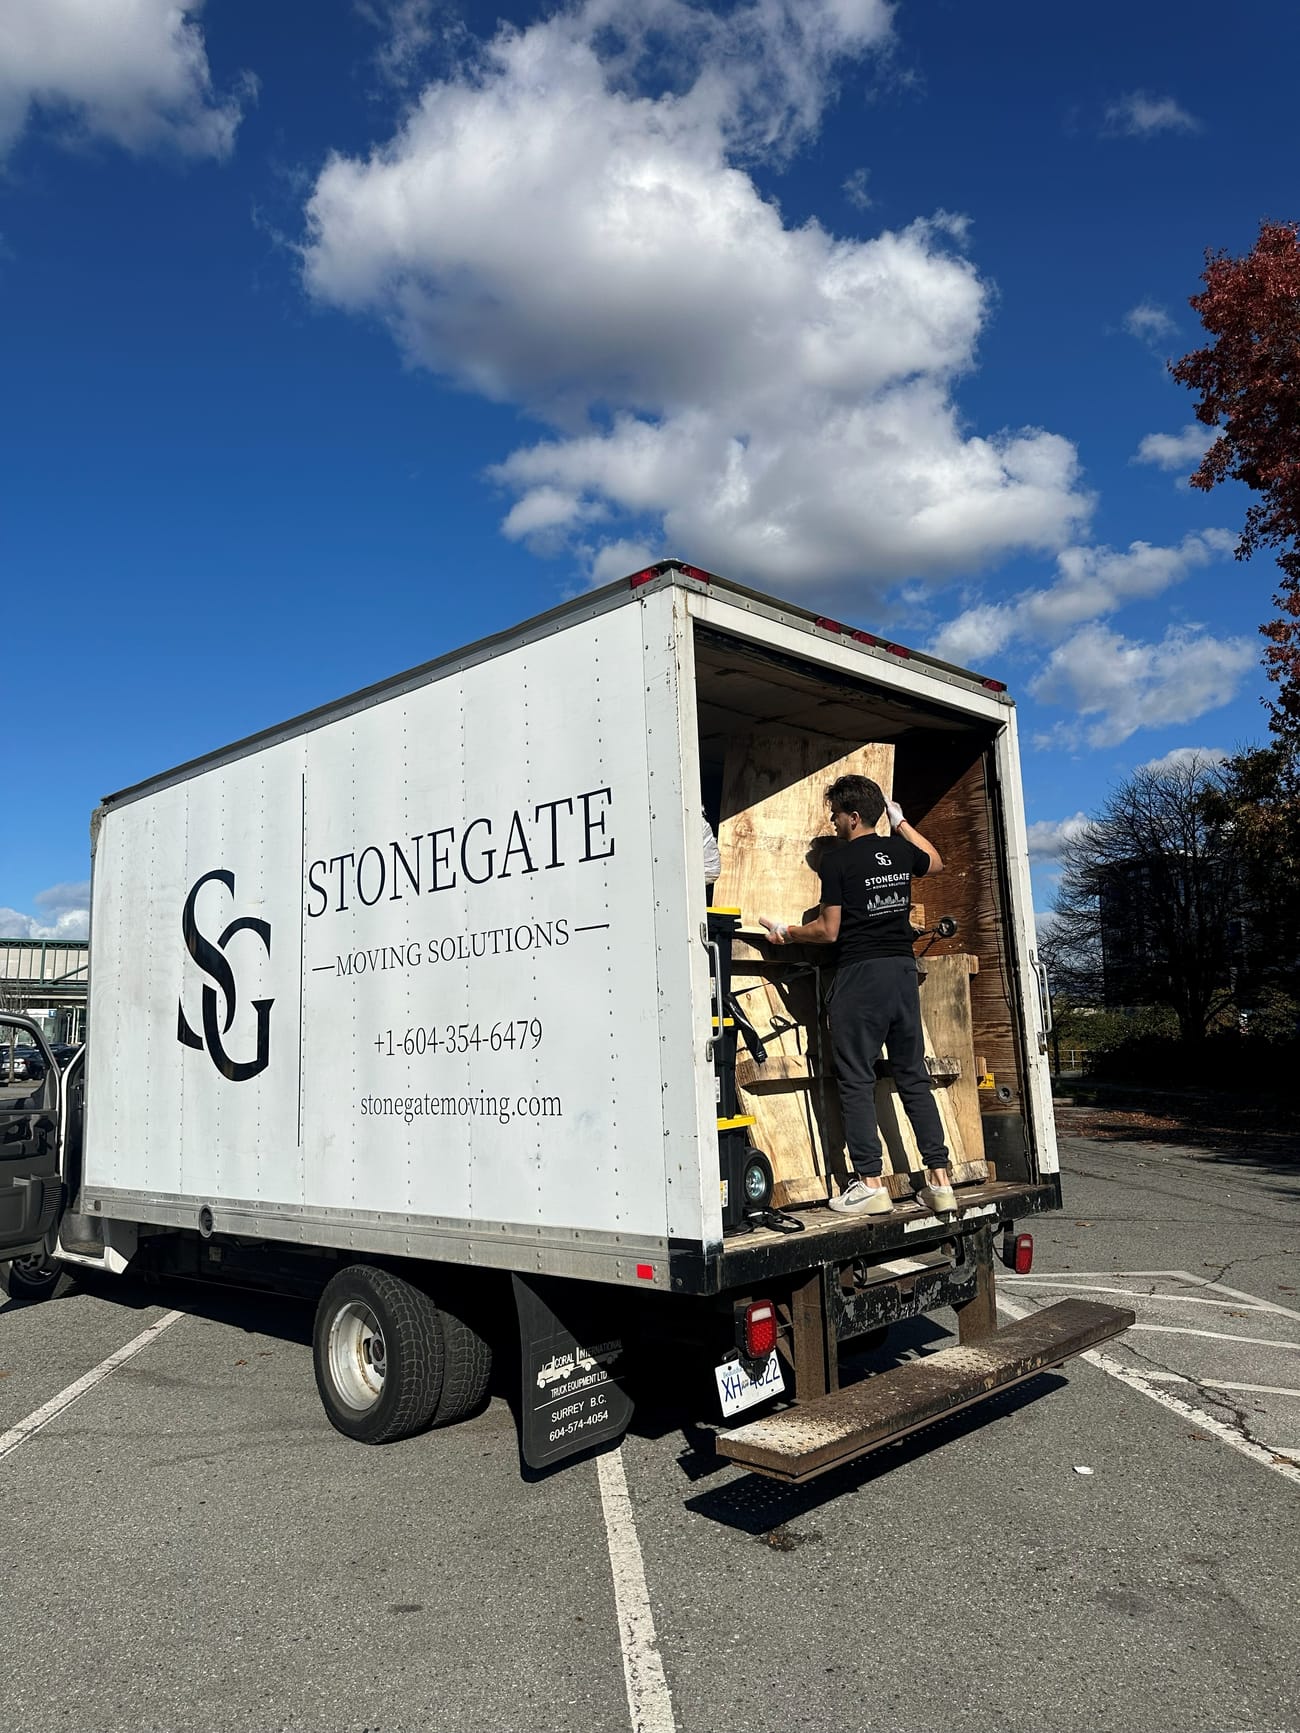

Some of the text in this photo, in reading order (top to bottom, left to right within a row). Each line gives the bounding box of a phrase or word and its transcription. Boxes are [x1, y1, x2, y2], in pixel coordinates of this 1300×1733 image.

[307, 787, 615, 917] STONEGATE
[875, 852, 892, 866] SG
[865, 872, 910, 887] STONEGATE
[336, 918, 570, 977] MOVING SOLUTIONS
[177, 869, 275, 1082] SG
[374, 1018, 543, 1056] +1-604-354-6479
[360, 1089, 563, 1123] stonegatemoving.com
[550, 1383, 568, 1398] TRUCK
[567, 1374, 597, 1391] EQUIPMENT
[721, 1374, 743, 1402] XH
[551, 1394, 607, 1423] SURREY B.C.
[549, 1409, 608, 1442] 604-574-4054
